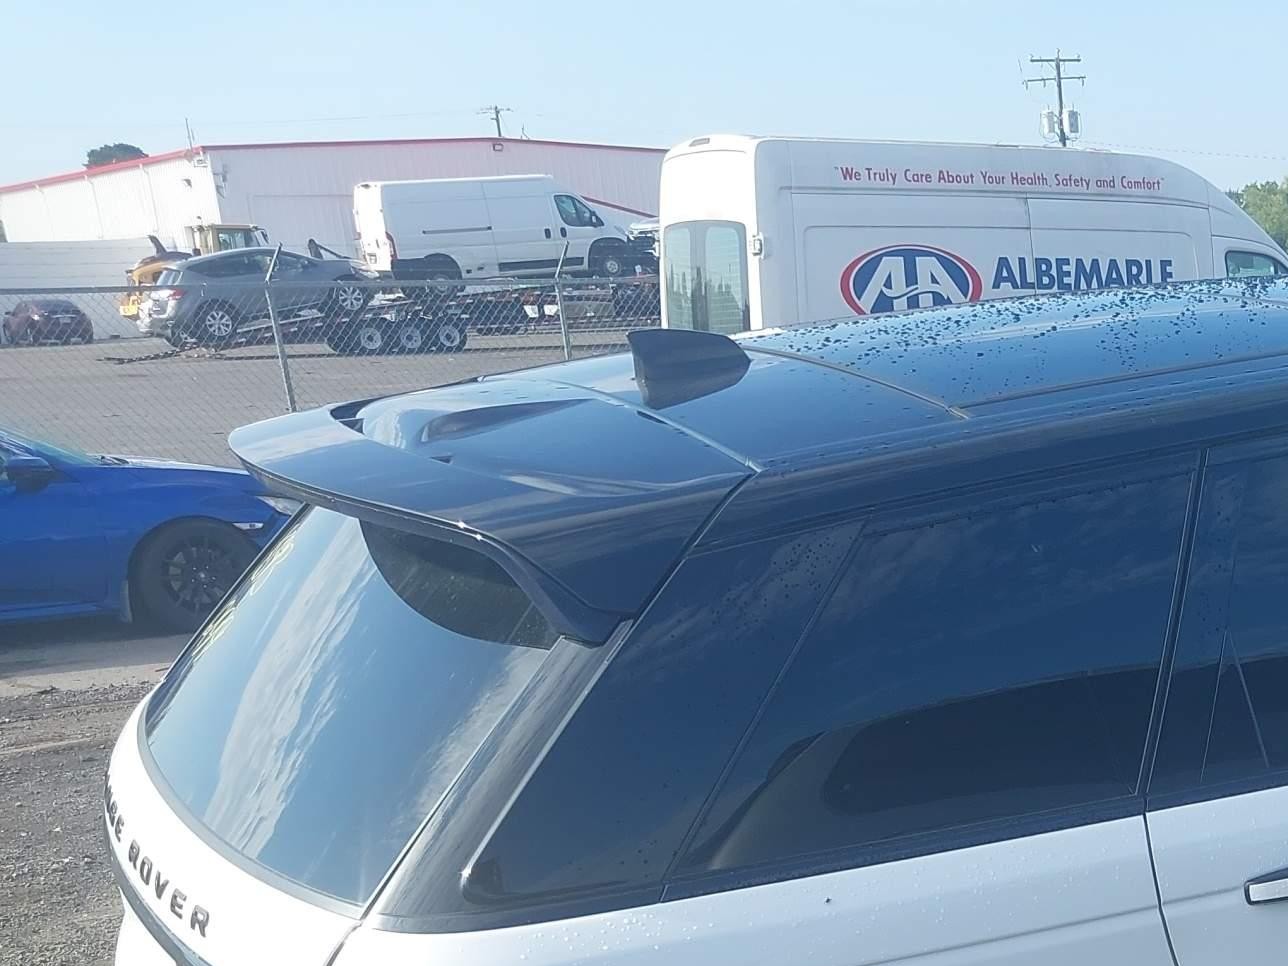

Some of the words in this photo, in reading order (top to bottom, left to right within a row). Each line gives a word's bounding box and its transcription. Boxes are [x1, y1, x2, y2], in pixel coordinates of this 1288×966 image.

[865, 167, 897, 186] Truly
[904, 168, 933, 184] Care
[937, 169, 975, 185] About
[980, 170, 1006, 186] Your
[1055, 173, 1091, 191] Safety
[1095, 175, 1116, 189] and
[128, 839, 210, 938] ROVER
